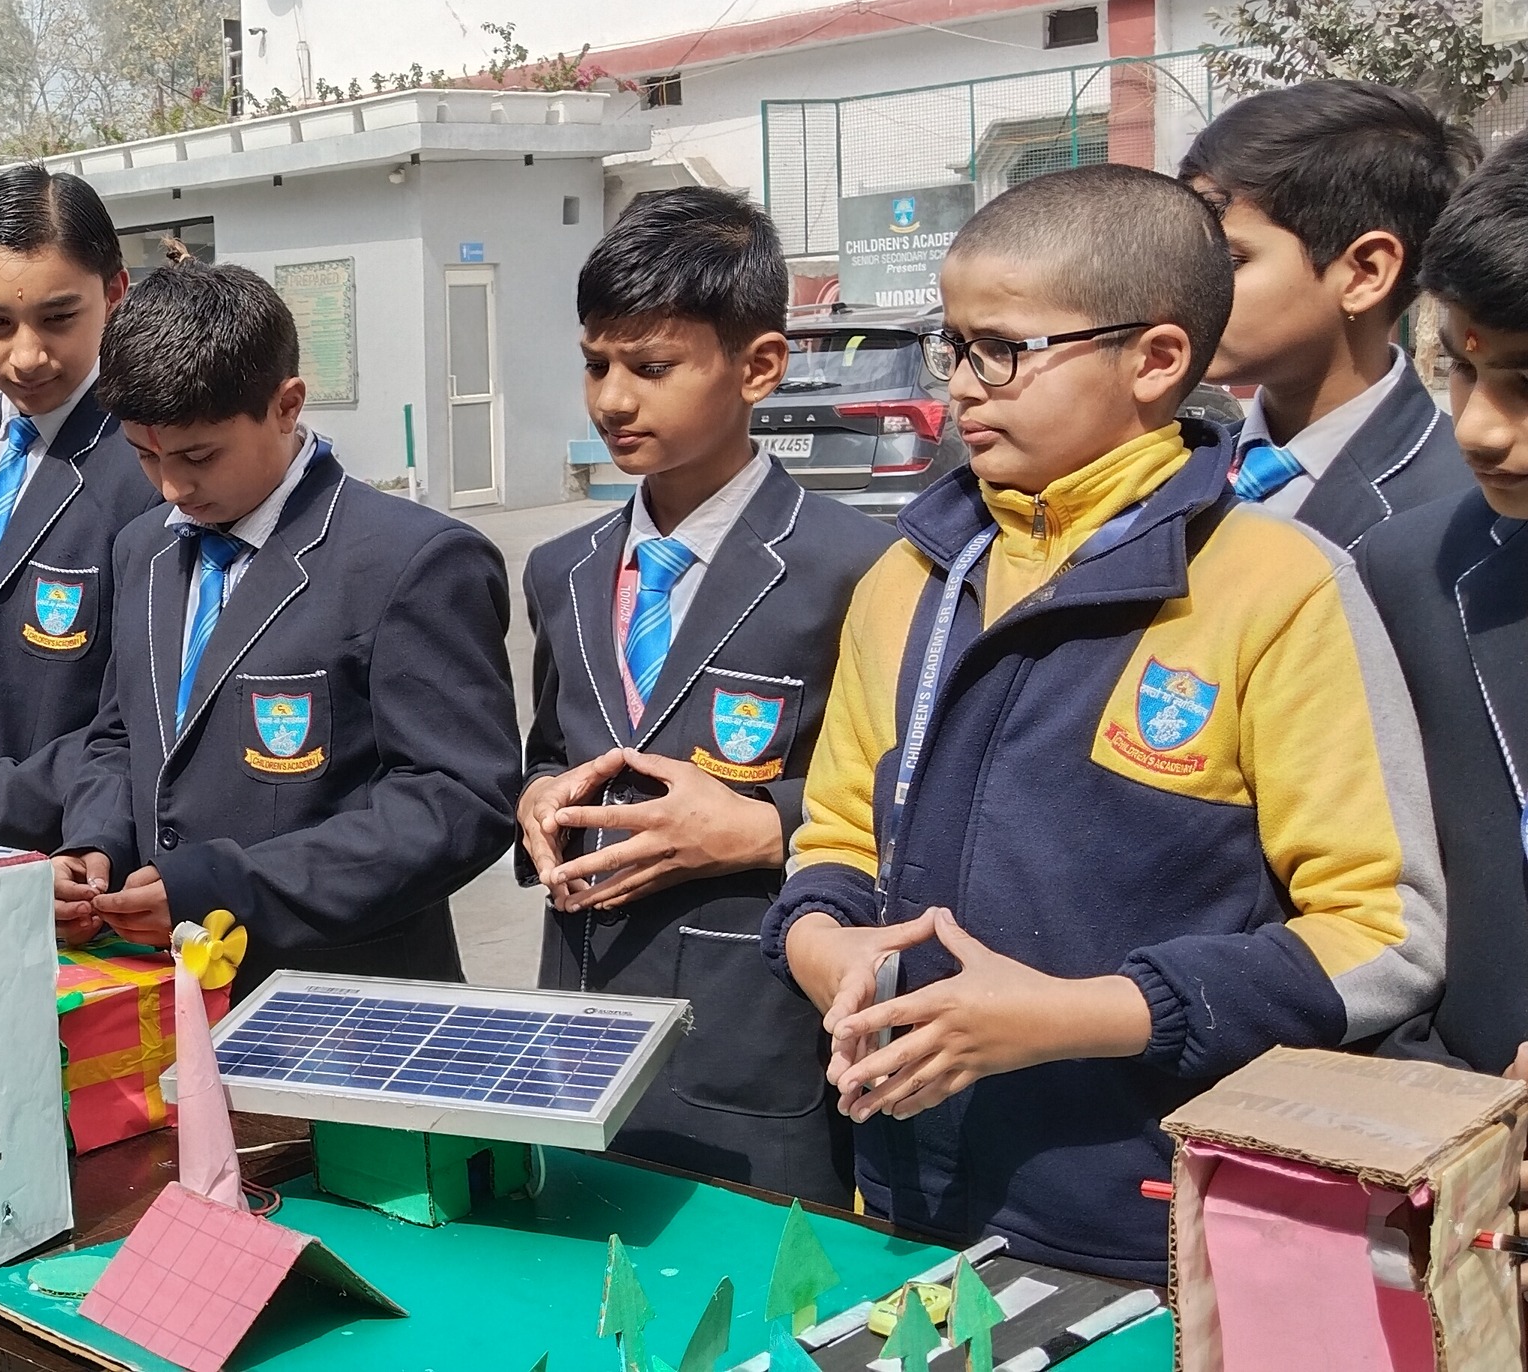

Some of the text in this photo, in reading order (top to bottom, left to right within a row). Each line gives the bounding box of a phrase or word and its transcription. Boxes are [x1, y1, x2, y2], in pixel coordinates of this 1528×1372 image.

[845, 231, 959, 255] CHILDREN'S ACADEM
[851, 249, 948, 266] SENIOR SECONDARY SCH
[886, 262, 927, 274] Presents
[875, 287, 943, 307] WORKS
[620, 585, 631, 624] SCHOOL
[905, 691, 931, 769] CHILDREN'S
[922, 628, 946, 689] ACADEMY
[938, 602, 952, 624] SR.
[956, 533, 991, 570] SCHOOL
